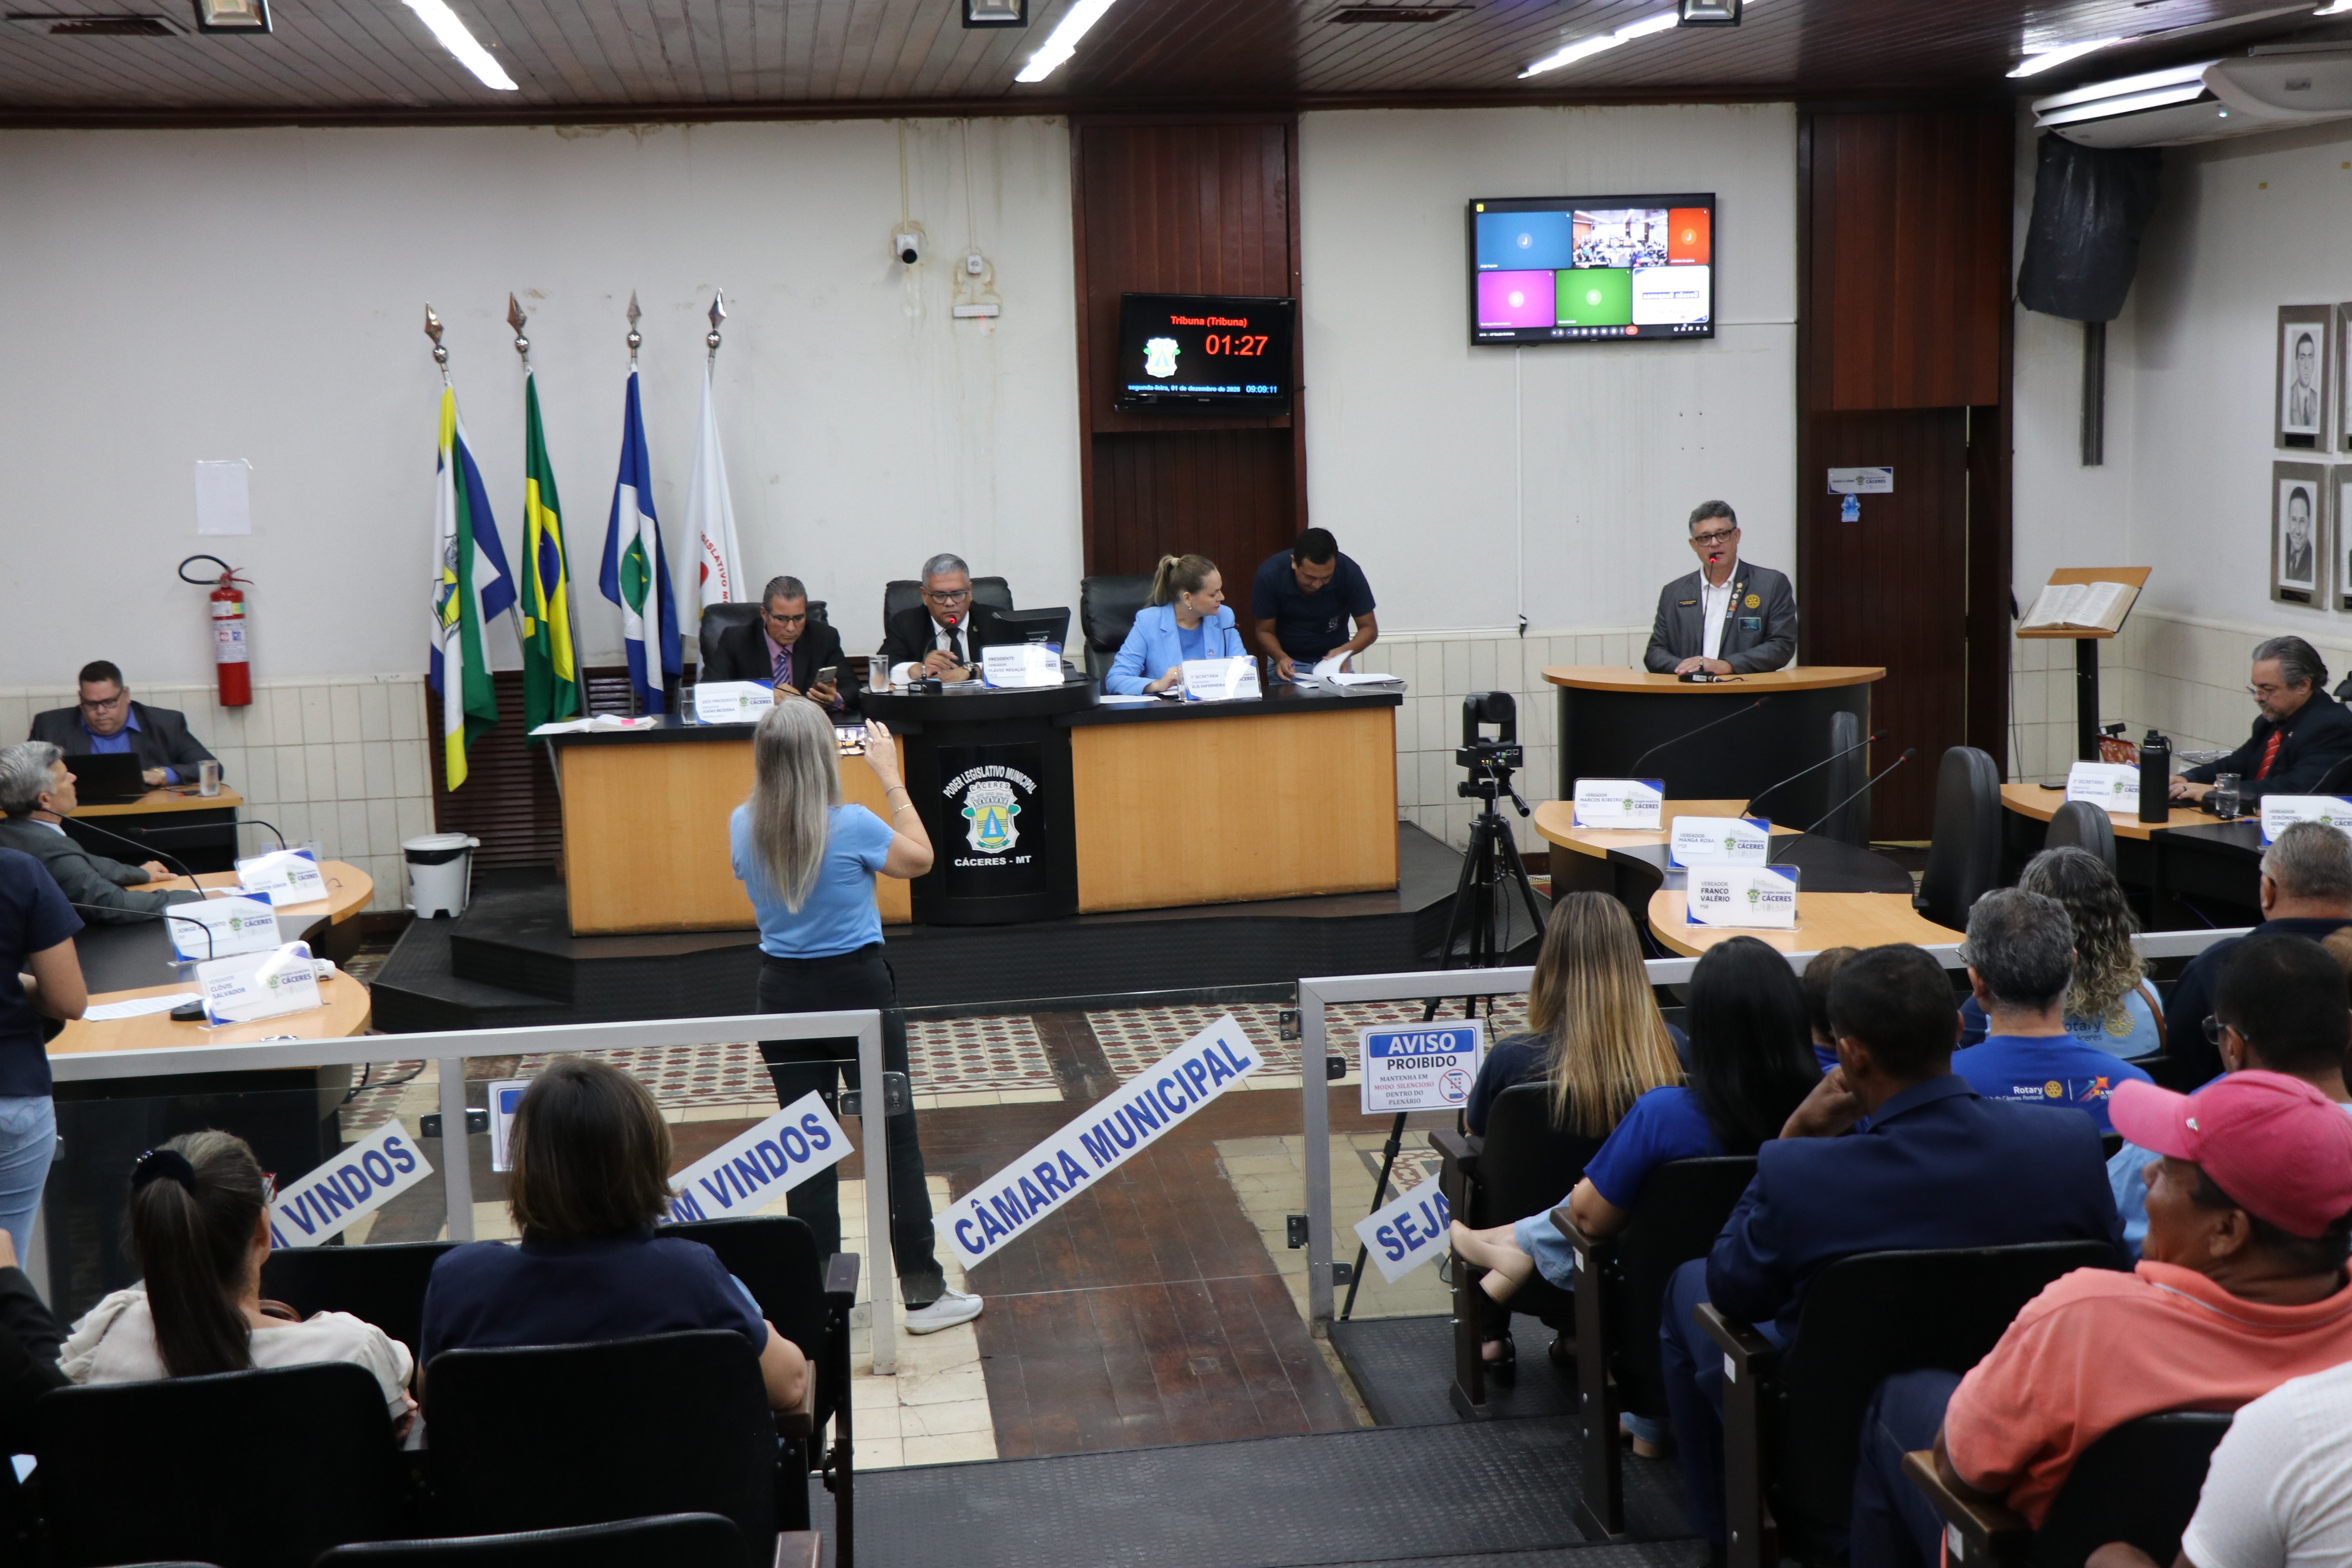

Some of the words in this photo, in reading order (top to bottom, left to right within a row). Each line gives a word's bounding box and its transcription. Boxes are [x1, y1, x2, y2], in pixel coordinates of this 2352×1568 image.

[1171, 316, 1205, 325] Tribuna
[1207, 317, 1248, 328] (Tribuna)
[1205, 335, 1269, 356] 01:27
[701, 531, 727, 587] GISLATIVO
[942, 776, 965, 799] PODER
[960, 765, 1005, 784] LEGISLATIVO
[1005, 767, 1037, 795] MUNICIPAL
[954, 857, 1007, 866] CÁCERES
[1015, 855, 1032, 864] MT
[199, 921, 226, 929] AGUSTO
[245, 918, 273, 927] CÁCERES
[281, 973, 312, 984] CÁCERES
[211, 983, 233, 992] CLÓVIS
[213, 987, 246, 999] SALVADOR
[2065, 1021, 2102, 1033] otary
[1388, 1033, 1456, 1055] AVISO
[1387, 1055, 1457, 1070] PROIBIDO
[2013, 1086, 2043, 1094] Rotary
[955, 1149, 1090, 1254] CÂMARA
[1080, 1038, 1252, 1168] MUNICIPAL
[699, 1113, 831, 1209] VINDOS
[280, 1136, 416, 1236] VINDOS
[1376, 1191, 1450, 1261] SEJA
